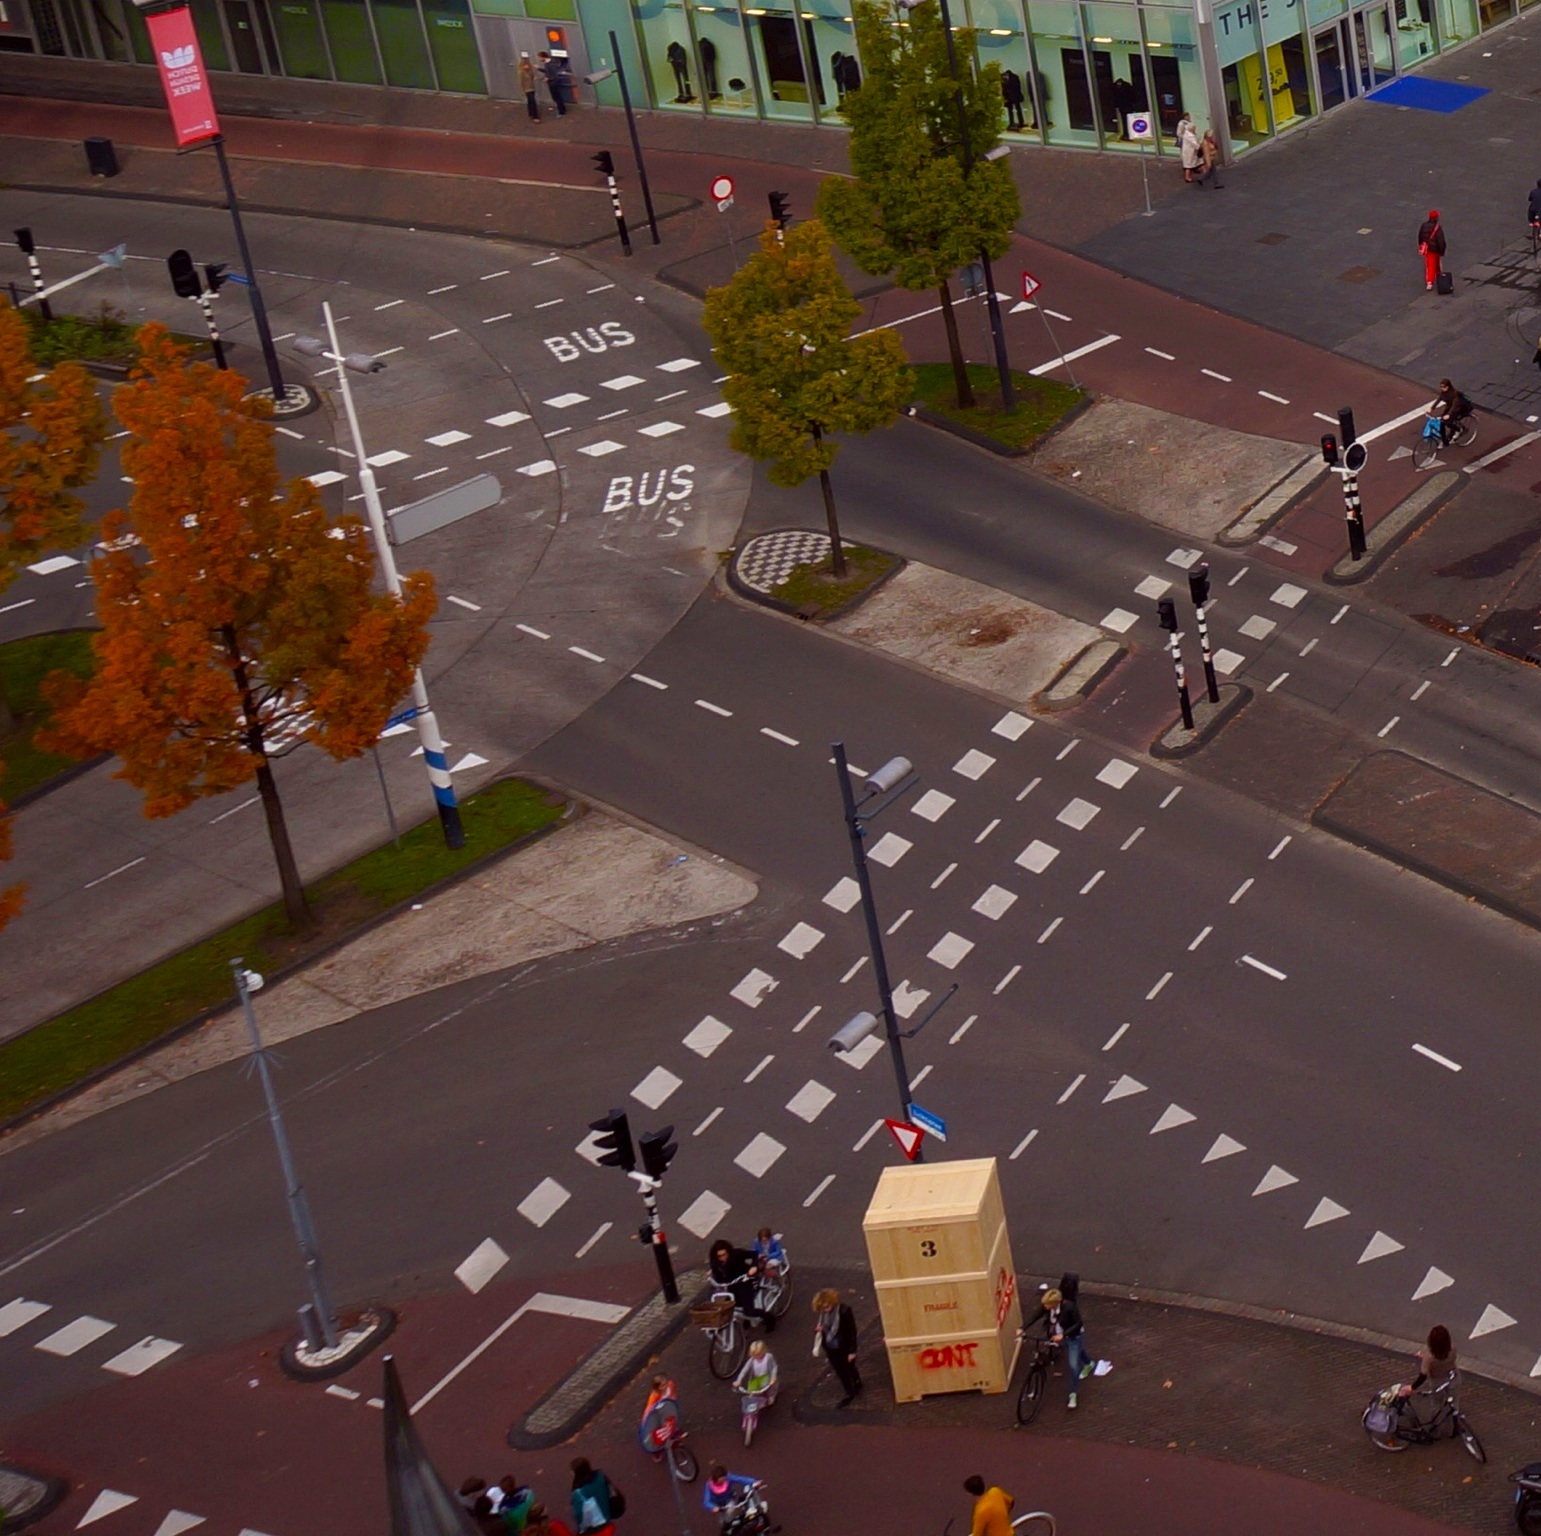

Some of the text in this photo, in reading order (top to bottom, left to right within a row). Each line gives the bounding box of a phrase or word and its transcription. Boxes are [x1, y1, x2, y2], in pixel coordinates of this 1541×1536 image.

[543, 321, 635, 363] BUS
[602, 464, 695, 513] BUS
[920, 1240, 938, 1257] 3
